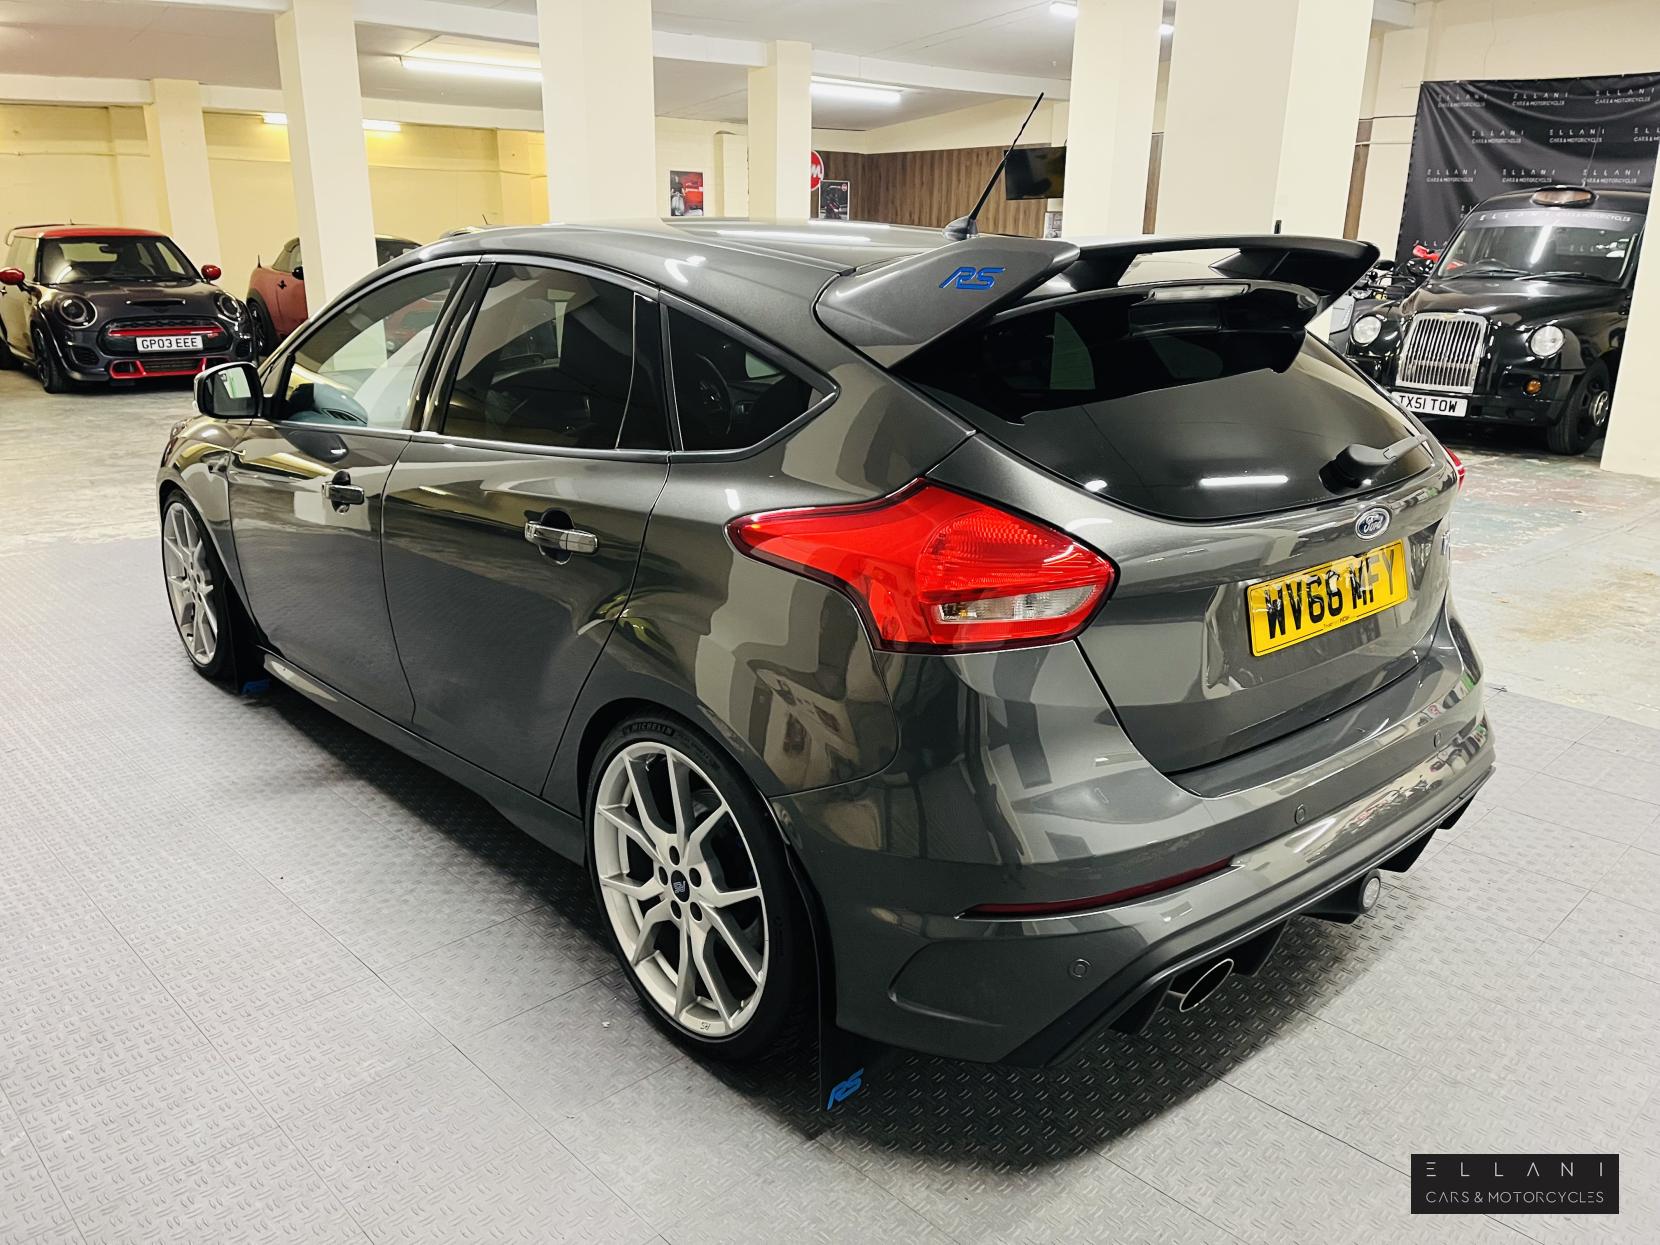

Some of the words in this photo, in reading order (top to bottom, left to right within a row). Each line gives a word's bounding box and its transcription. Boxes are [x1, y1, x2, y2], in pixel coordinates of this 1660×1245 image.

[1549, 128, 1605, 136] ELLANI
[939, 266, 1006, 290] RS
[141, 339, 173, 349] GP03
[175, 337, 198, 348] EEE
[1399, 395, 1427, 410] TX51
[1430, 398, 1458, 413] TOW
[1264, 569, 1343, 640] WV66
